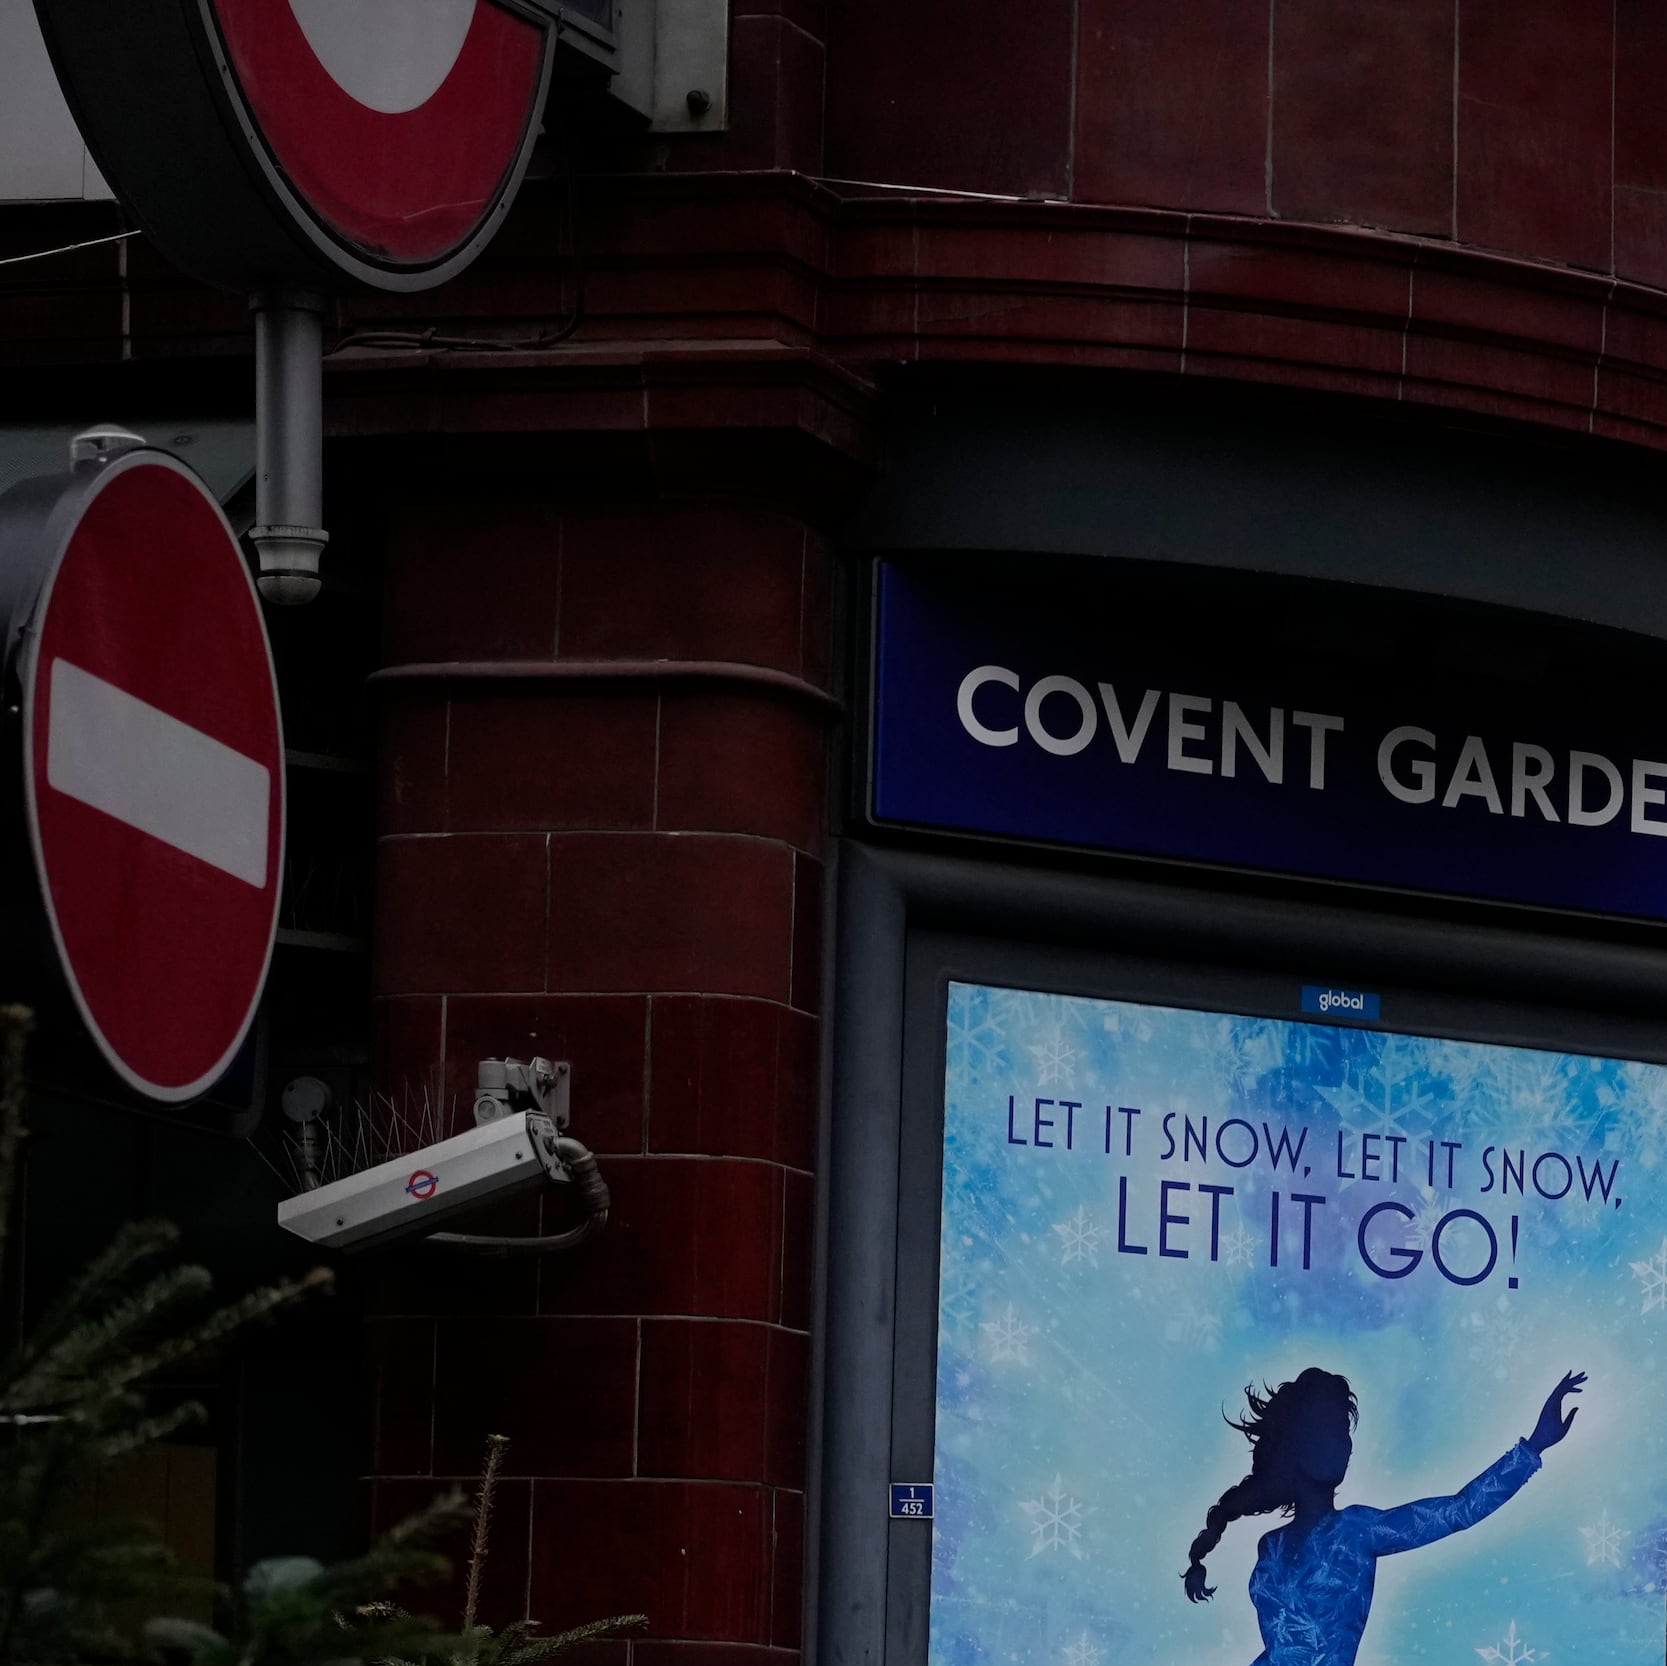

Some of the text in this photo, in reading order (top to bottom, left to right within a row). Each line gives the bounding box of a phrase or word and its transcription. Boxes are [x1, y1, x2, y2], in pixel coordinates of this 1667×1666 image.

[955, 664, 1344, 791] COVENT
[1319, 989, 1364, 1011] global
[1007, 1095, 1622, 1210] LET IT SNOW, LET IT SNOW,
[1117, 1176, 1519, 1289] LET IT GO!
[901, 1503, 923, 1515] 452
[909, 1487, 915, 1499] 1
